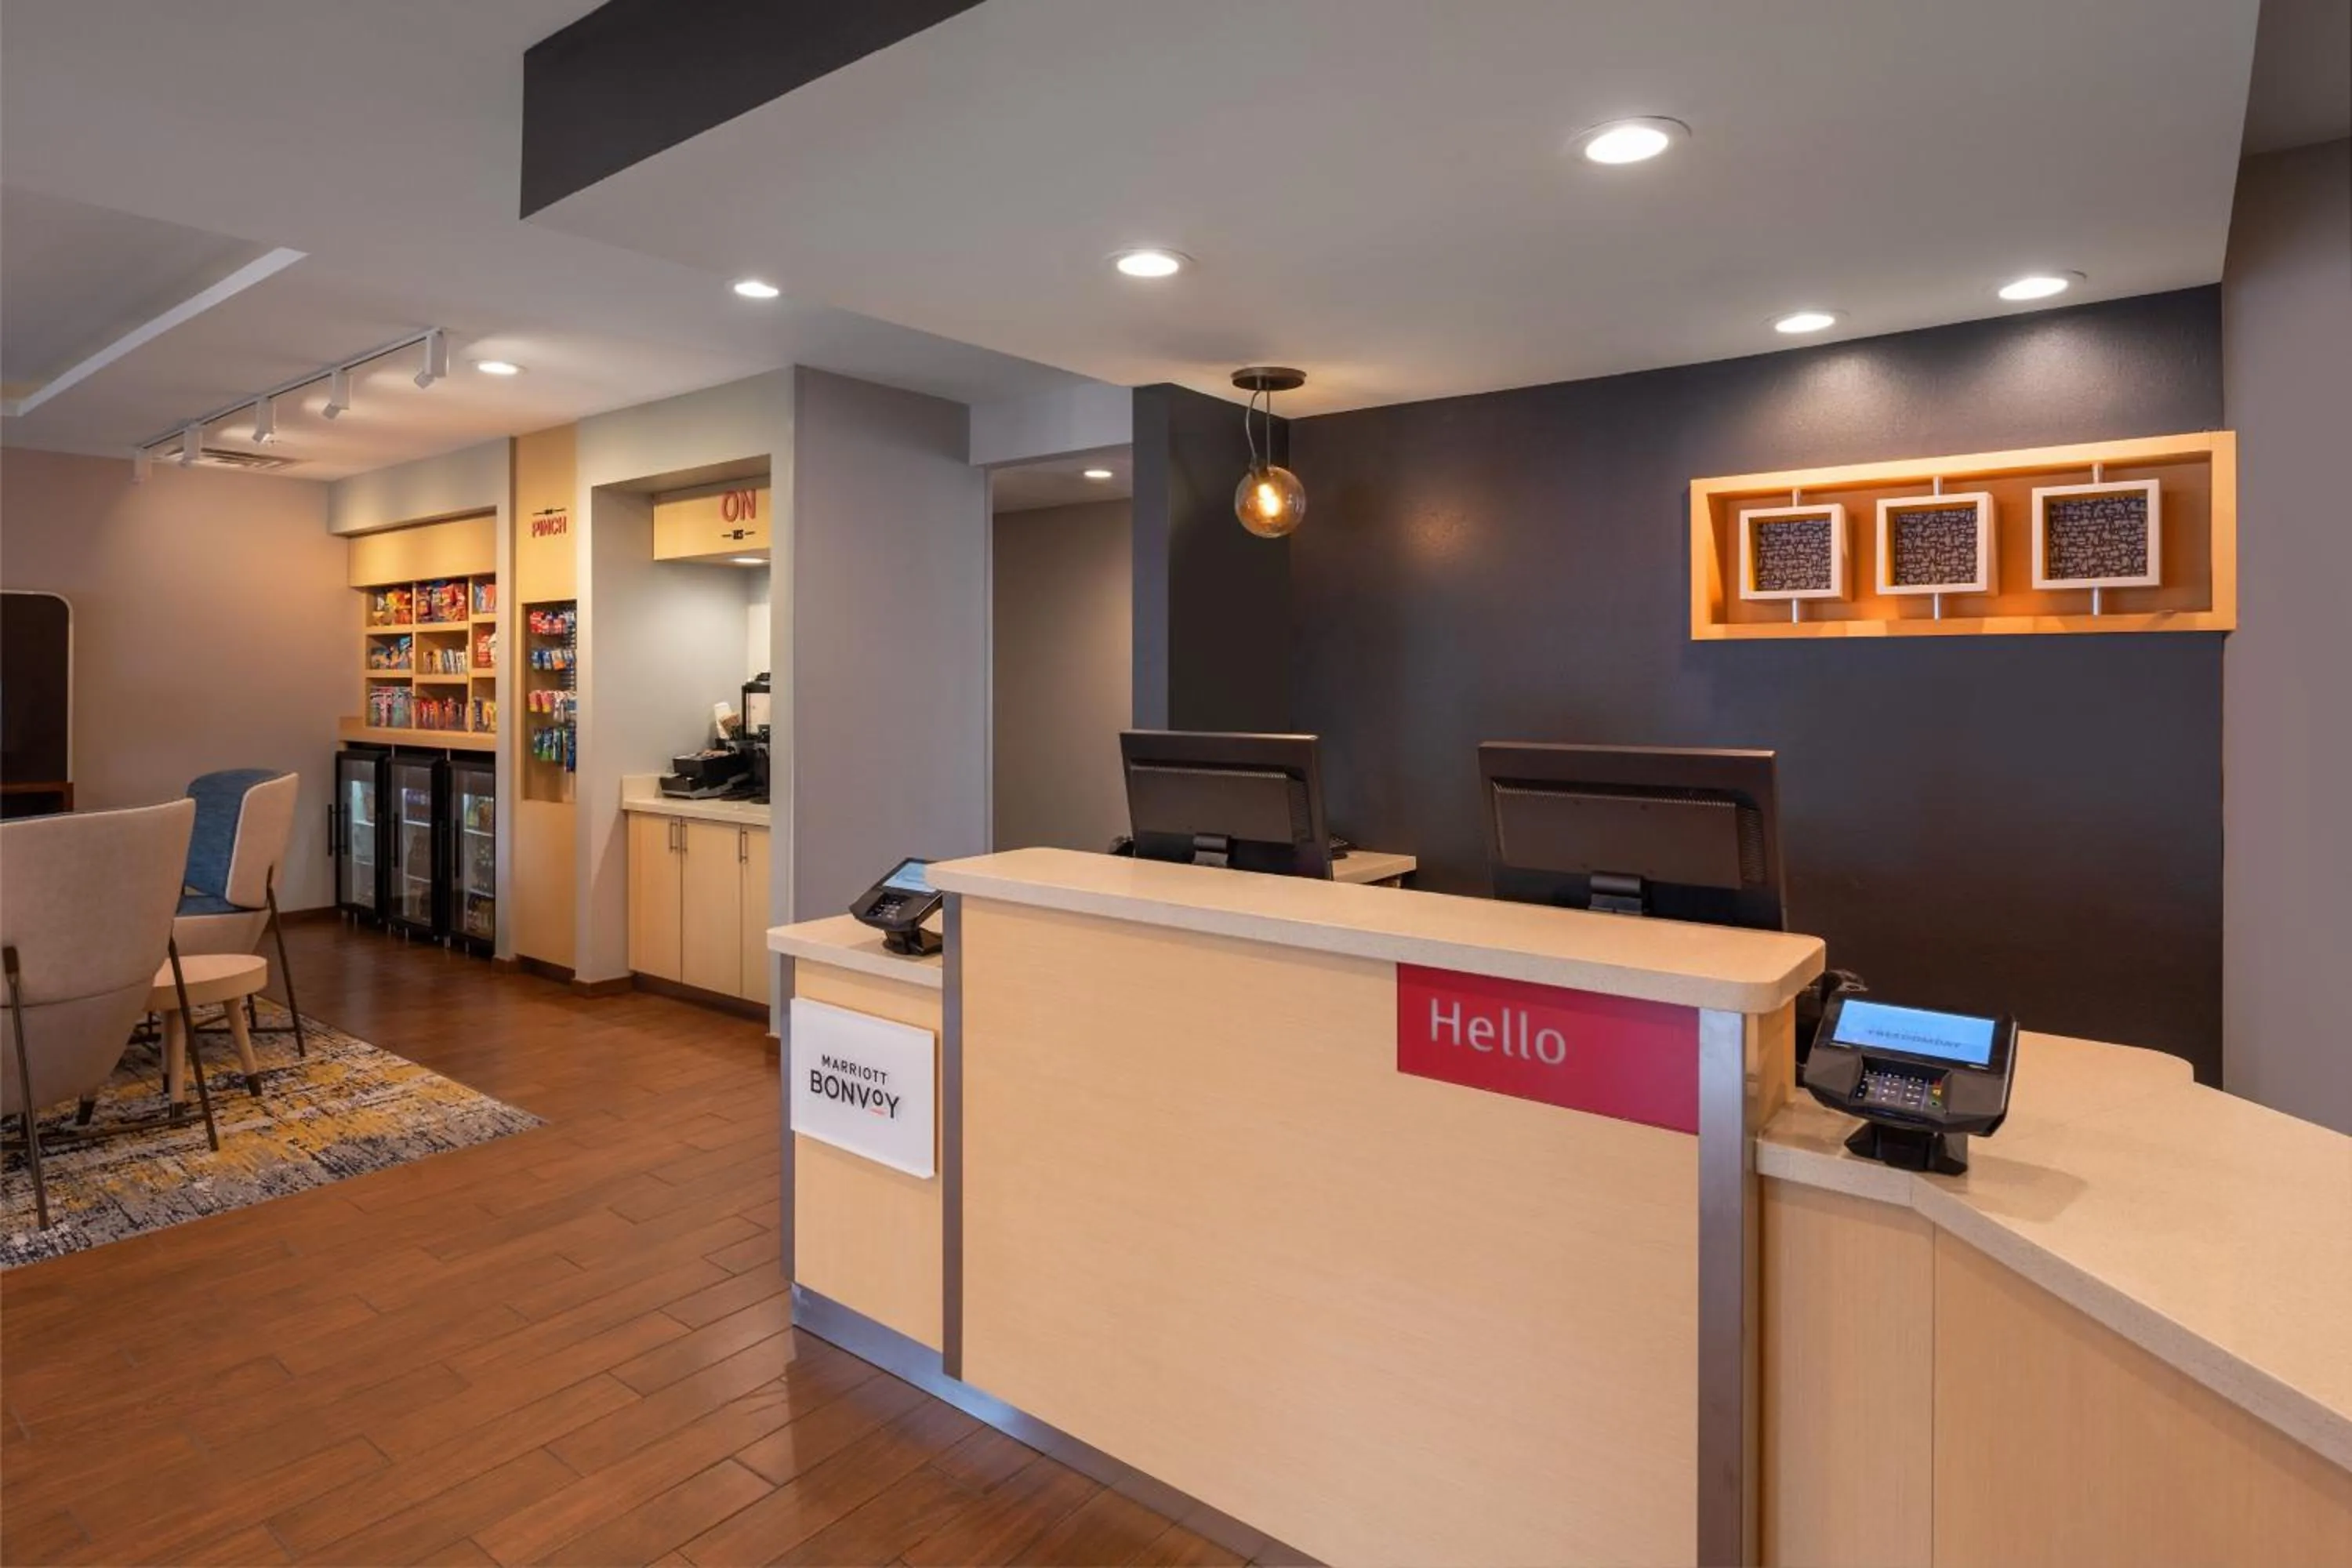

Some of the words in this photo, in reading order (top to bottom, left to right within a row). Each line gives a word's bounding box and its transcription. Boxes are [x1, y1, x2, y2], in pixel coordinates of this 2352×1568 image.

[721, 488, 756, 523] ON
[532, 516, 567, 538] PINCH
[1430, 997, 1566, 1065] Hello
[821, 1054, 888, 1085] MARRIOTT
[810, 1069, 900, 1120] BONVOY
